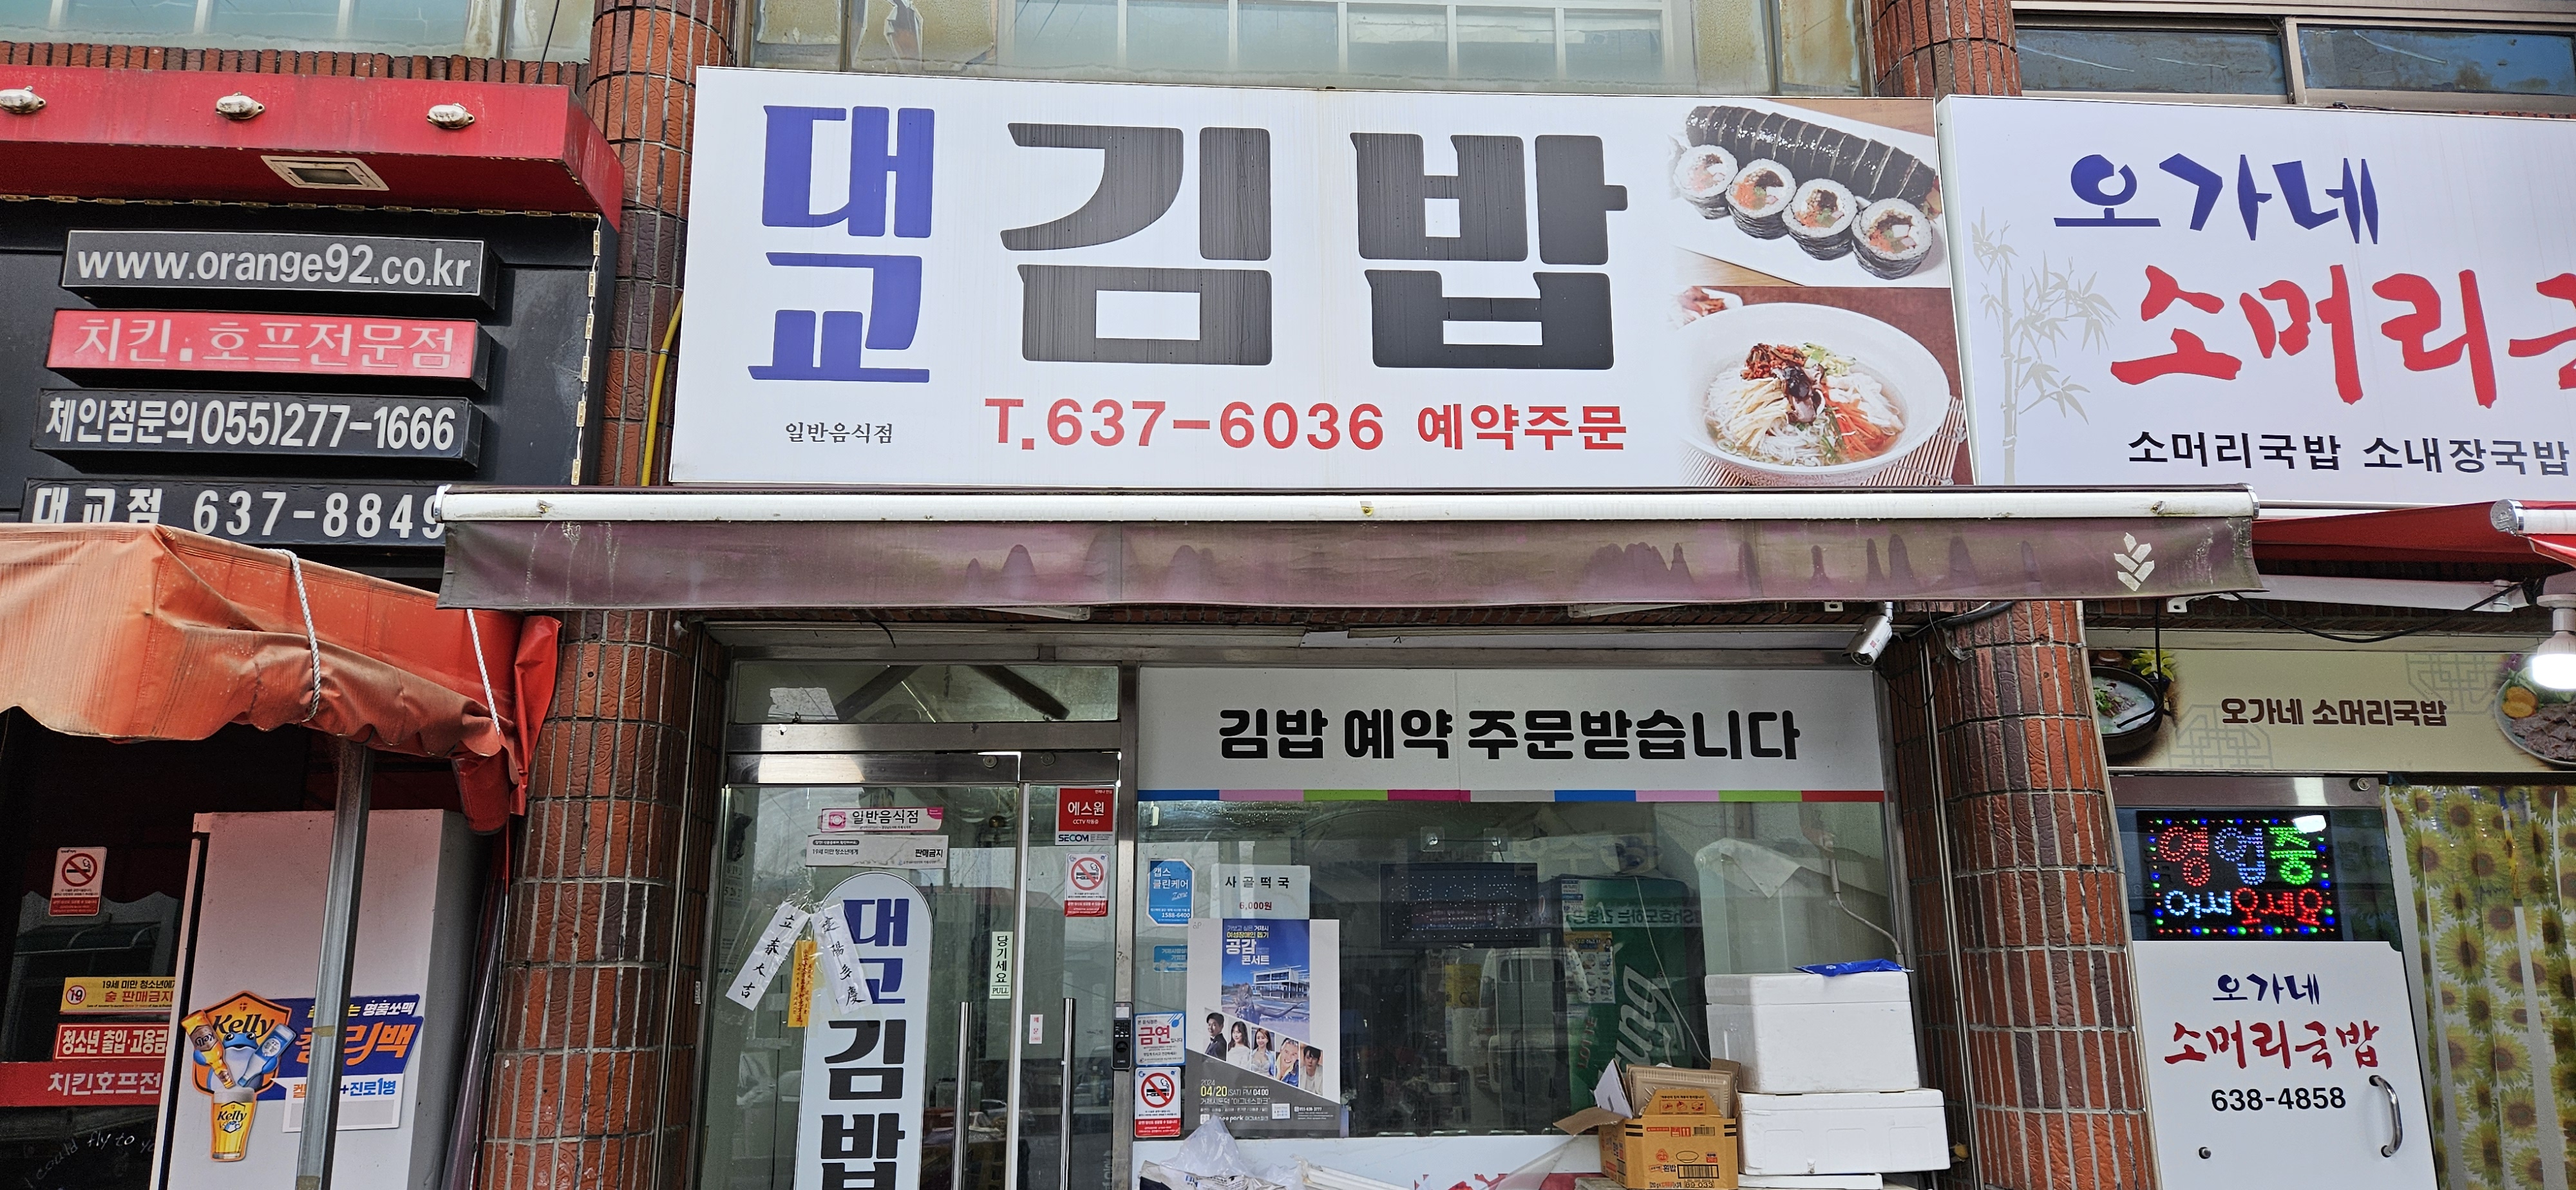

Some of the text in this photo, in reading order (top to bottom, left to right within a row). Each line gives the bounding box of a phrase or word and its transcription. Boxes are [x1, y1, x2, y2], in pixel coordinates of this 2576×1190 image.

[2054, 152, 2378, 245] 오가네
[748, 105, 934, 383] 대교
[1000, 122, 1628, 370] 김밥
[77, 242, 471, 288] www.orange92.co.kr
[785, 420, 893, 444] 일반음식점
[985, 398, 1627, 451] T.637-6036 예약주문
[2128, 430, 2570, 477] 소머리국밥 소내장국밥
[2221, 698, 2448, 727] 오가네 소머리국밥
[1218, 708, 1801, 760] 김밥 예약 주문받습니다
[852, 809, 919, 824] 일반음식점
[1068, 802, 1104, 816] 에스원
[915, 849, 943, 858] 판매금지
[2159, 826, 2317, 887] 영업중
[1153, 867, 1171, 877] 캡스
[1239, 902, 1273, 911] 6,000원
[994, 934, 1009, 983] 당기세요
[1226, 938, 1257, 955] 공감
[1242, 955, 1269, 965] 콘서트
[102, 980, 119, 989] 19세
[121, 980, 138, 989] 미만
[105, 990, 173, 1003] 술 판매금지
[2212, 973, 2320, 1005] 오가네
[363, 999, 416, 1017] 명품쏘맥
[213, 1014, 276, 1039] Kelly
[1138, 1025, 1171, 1045] 금연
[62, 1029, 167, 1055] 청소년 출입·고용금
[2164, 1019, 2380, 1070] 소머리국밥
[1200, 1086, 1227, 1097] 04/20
[2211, 1086, 2347, 1112] 638-4858
[217, 1110, 247, 1122] Kelly
